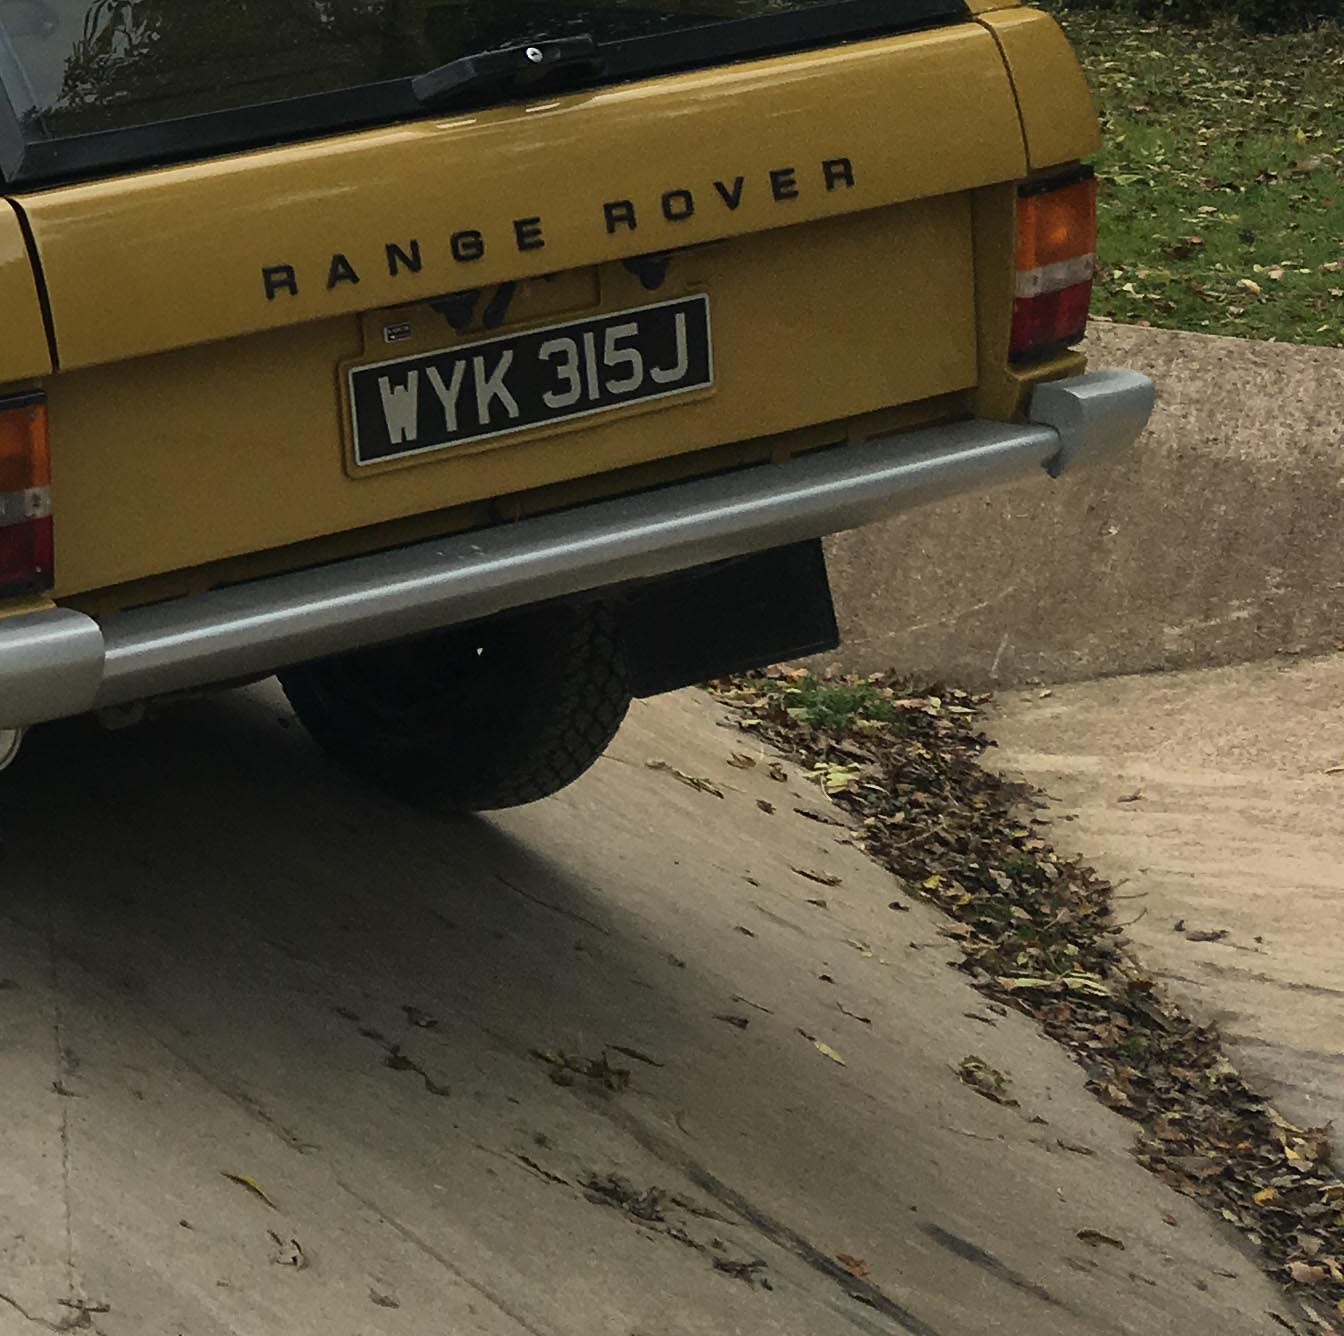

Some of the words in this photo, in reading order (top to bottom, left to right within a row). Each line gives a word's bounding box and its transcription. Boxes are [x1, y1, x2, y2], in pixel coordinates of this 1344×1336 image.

[262, 216, 545, 300] RANGE
[603, 158, 855, 234] ROVER
[378, 349, 520, 444] WYK
[538, 312, 689, 409] 315J
